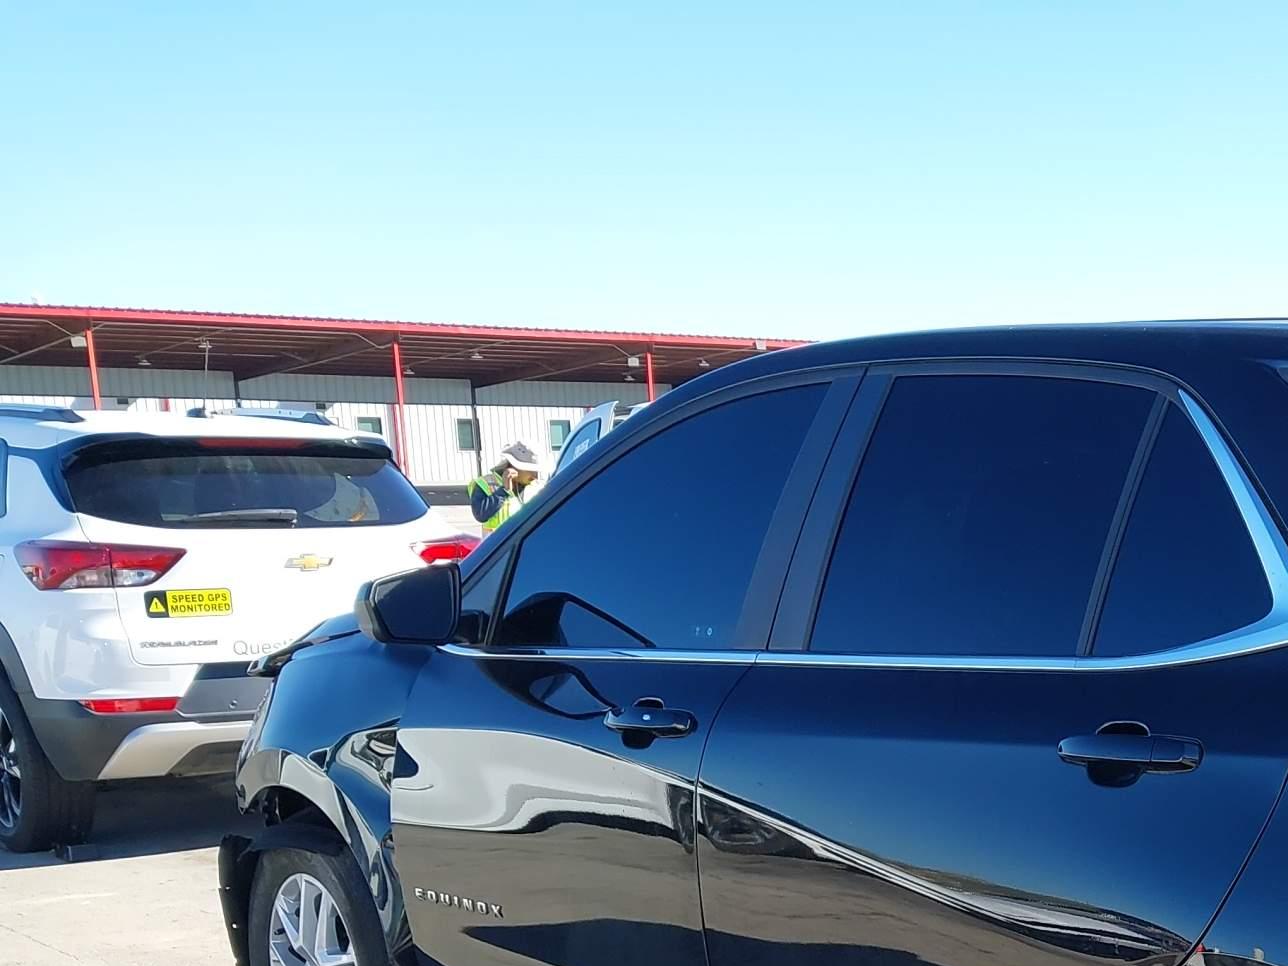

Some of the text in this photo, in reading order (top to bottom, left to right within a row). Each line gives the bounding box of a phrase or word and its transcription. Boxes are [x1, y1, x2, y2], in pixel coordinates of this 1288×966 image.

[171, 593, 228, 603] SPEED GPS
[170, 603, 231, 614] MONITORED
[414, 887, 505, 920] EQUINOX
